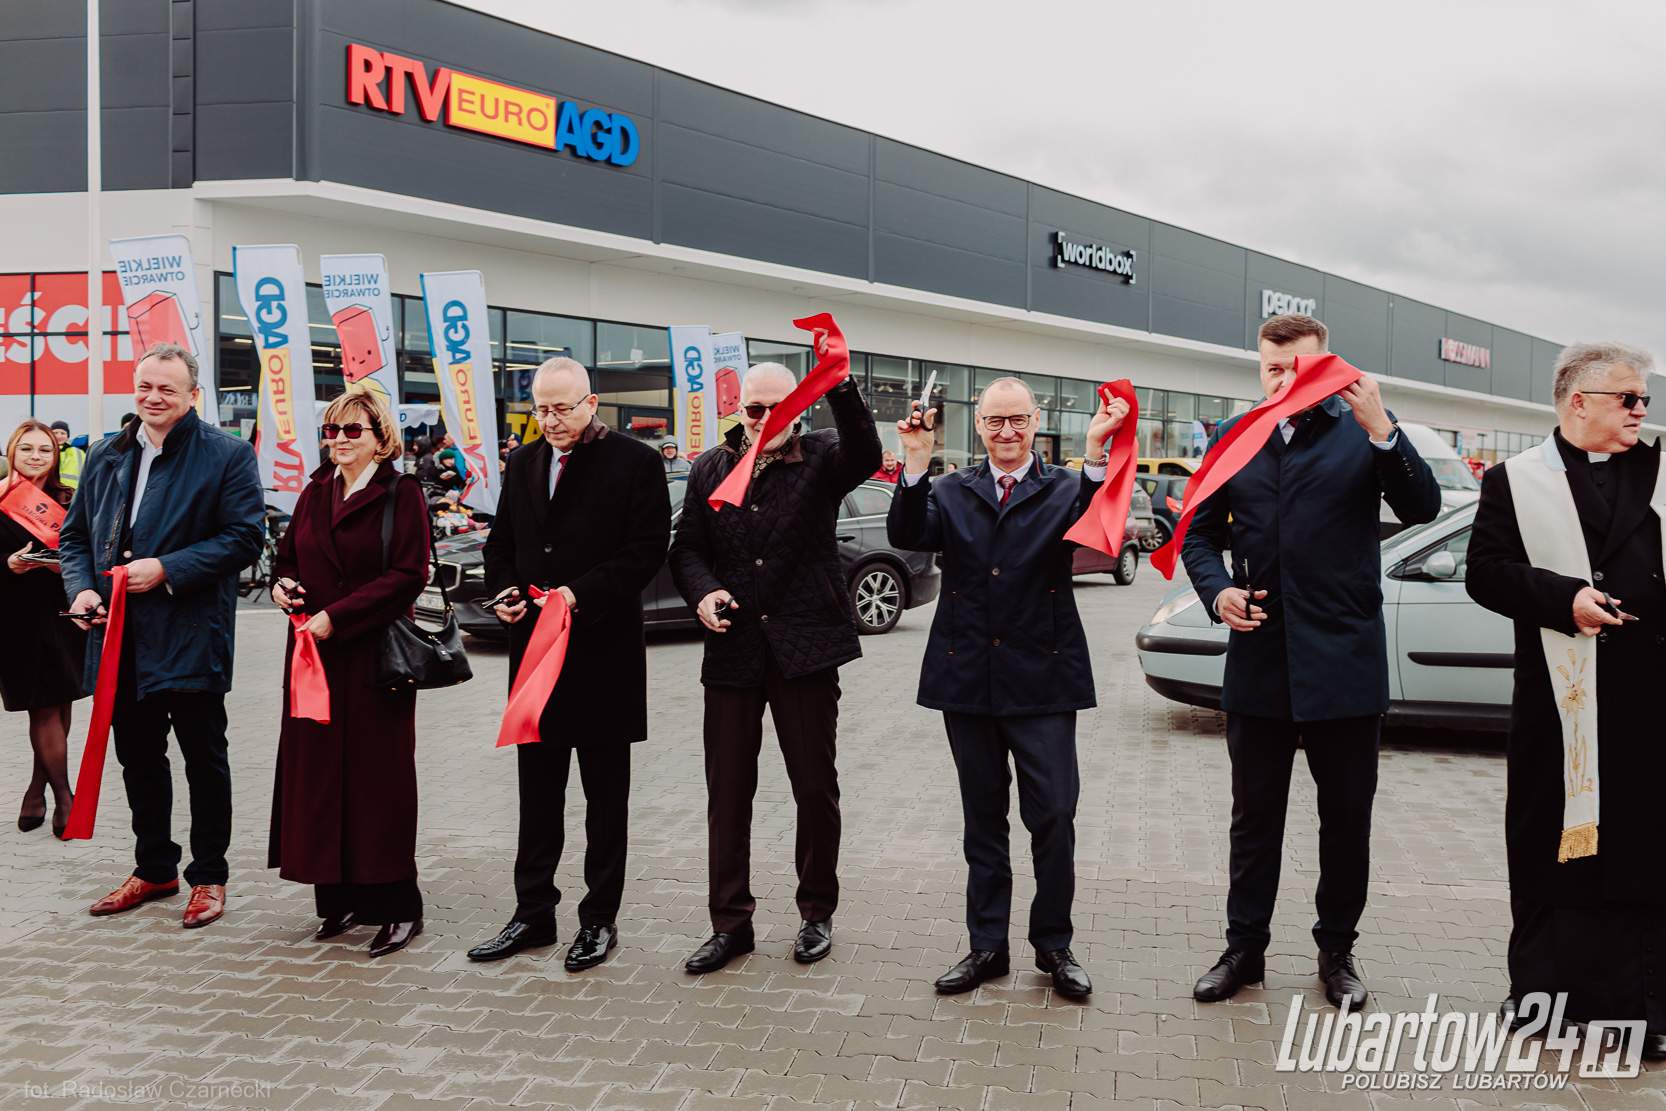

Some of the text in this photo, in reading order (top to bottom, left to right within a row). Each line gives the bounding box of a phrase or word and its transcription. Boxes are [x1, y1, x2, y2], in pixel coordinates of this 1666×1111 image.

[346, 43, 640, 167] RTV EURO AGD
[1062, 240, 1132, 276] worldbox
